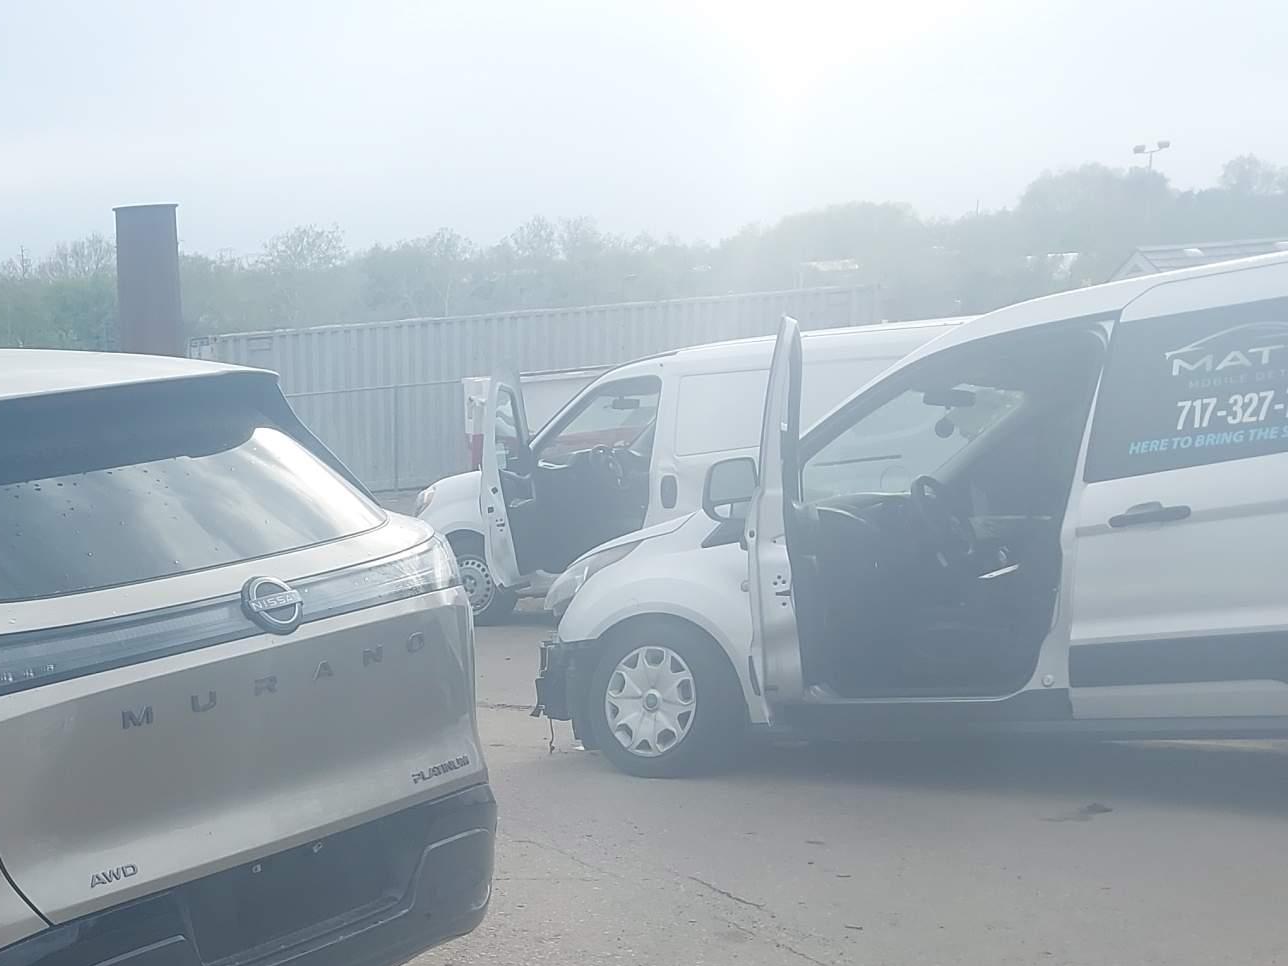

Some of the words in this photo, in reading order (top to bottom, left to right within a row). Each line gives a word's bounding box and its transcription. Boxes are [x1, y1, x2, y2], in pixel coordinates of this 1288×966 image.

[1172, 345, 1285, 376] MAT
[1176, 390, 1288, 430] 717-327-
[1128, 438, 1169, 455] HERE
[1171, 434, 1193, 450] TO
[1194, 430, 1245, 448] BRING
[1249, 426, 1279, 441] THE
[122, 631, 426, 730] MURANO
[90, 864, 138, 888] AWD
